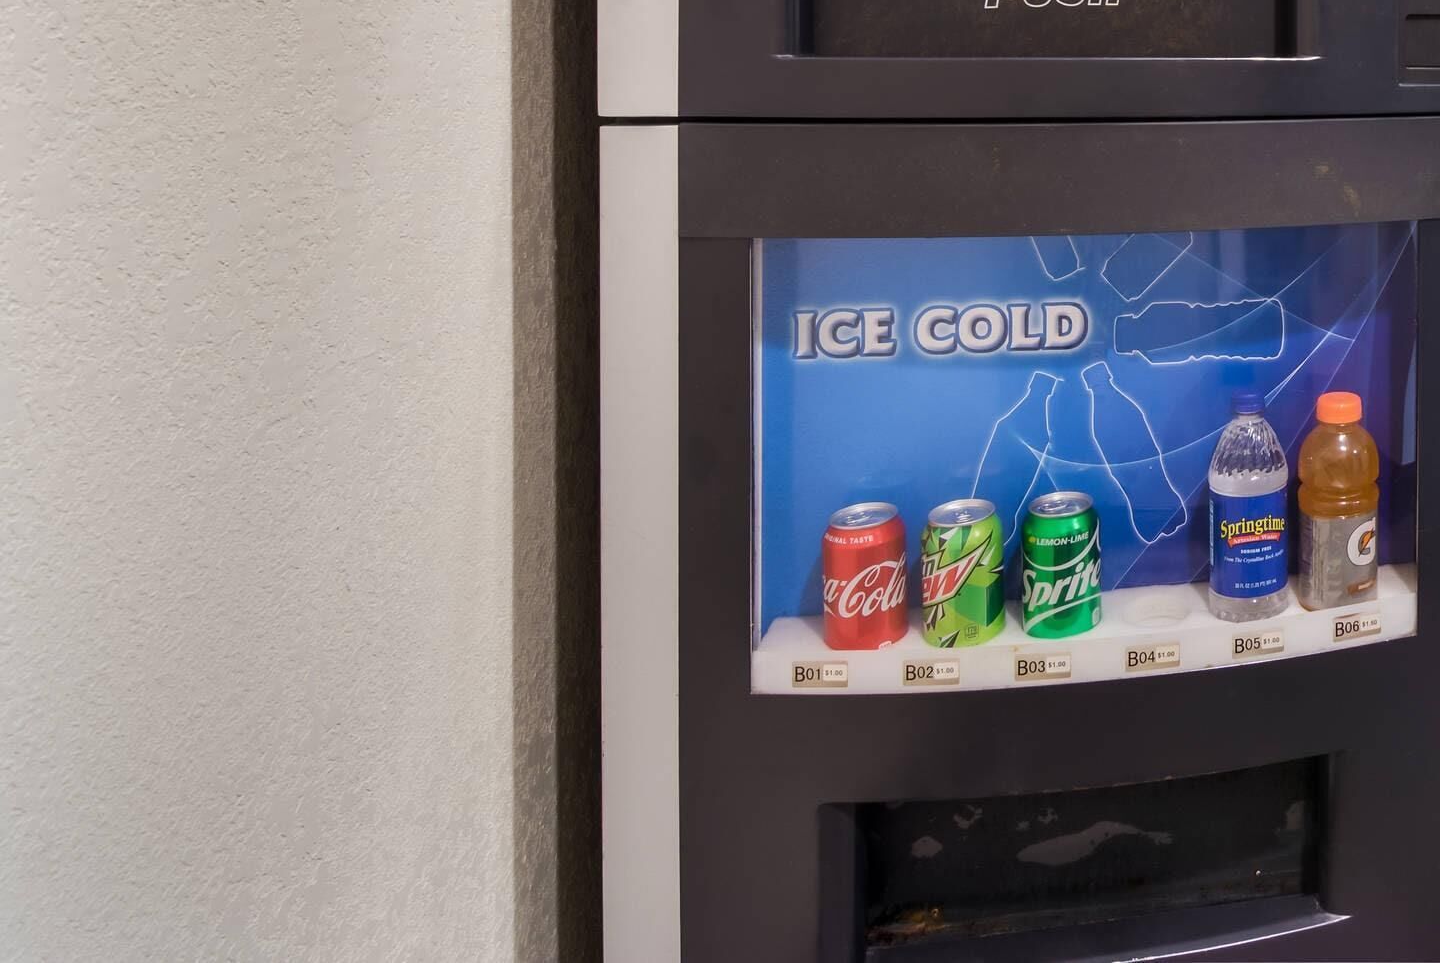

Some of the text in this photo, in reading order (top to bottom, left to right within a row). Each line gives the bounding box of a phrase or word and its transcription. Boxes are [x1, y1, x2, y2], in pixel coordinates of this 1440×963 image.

[792, 302, 1088, 359] ICE COLD
[1221, 514, 1285, 540] Springtime
[849, 535, 874, 544] TASTE
[1036, 531, 1089, 546] LEMON-LIME
[1022, 557, 1101, 612] Sprite
[1335, 619, 1378, 637] B06 $1.50
[1234, 637, 1280, 653] B05 $1.00
[1128, 651, 1175, 667] B04 $1.00
[794, 666, 821, 682] B01
[906, 665, 955, 681] B02 $1.00
[1017, 660, 1045, 676] B03
